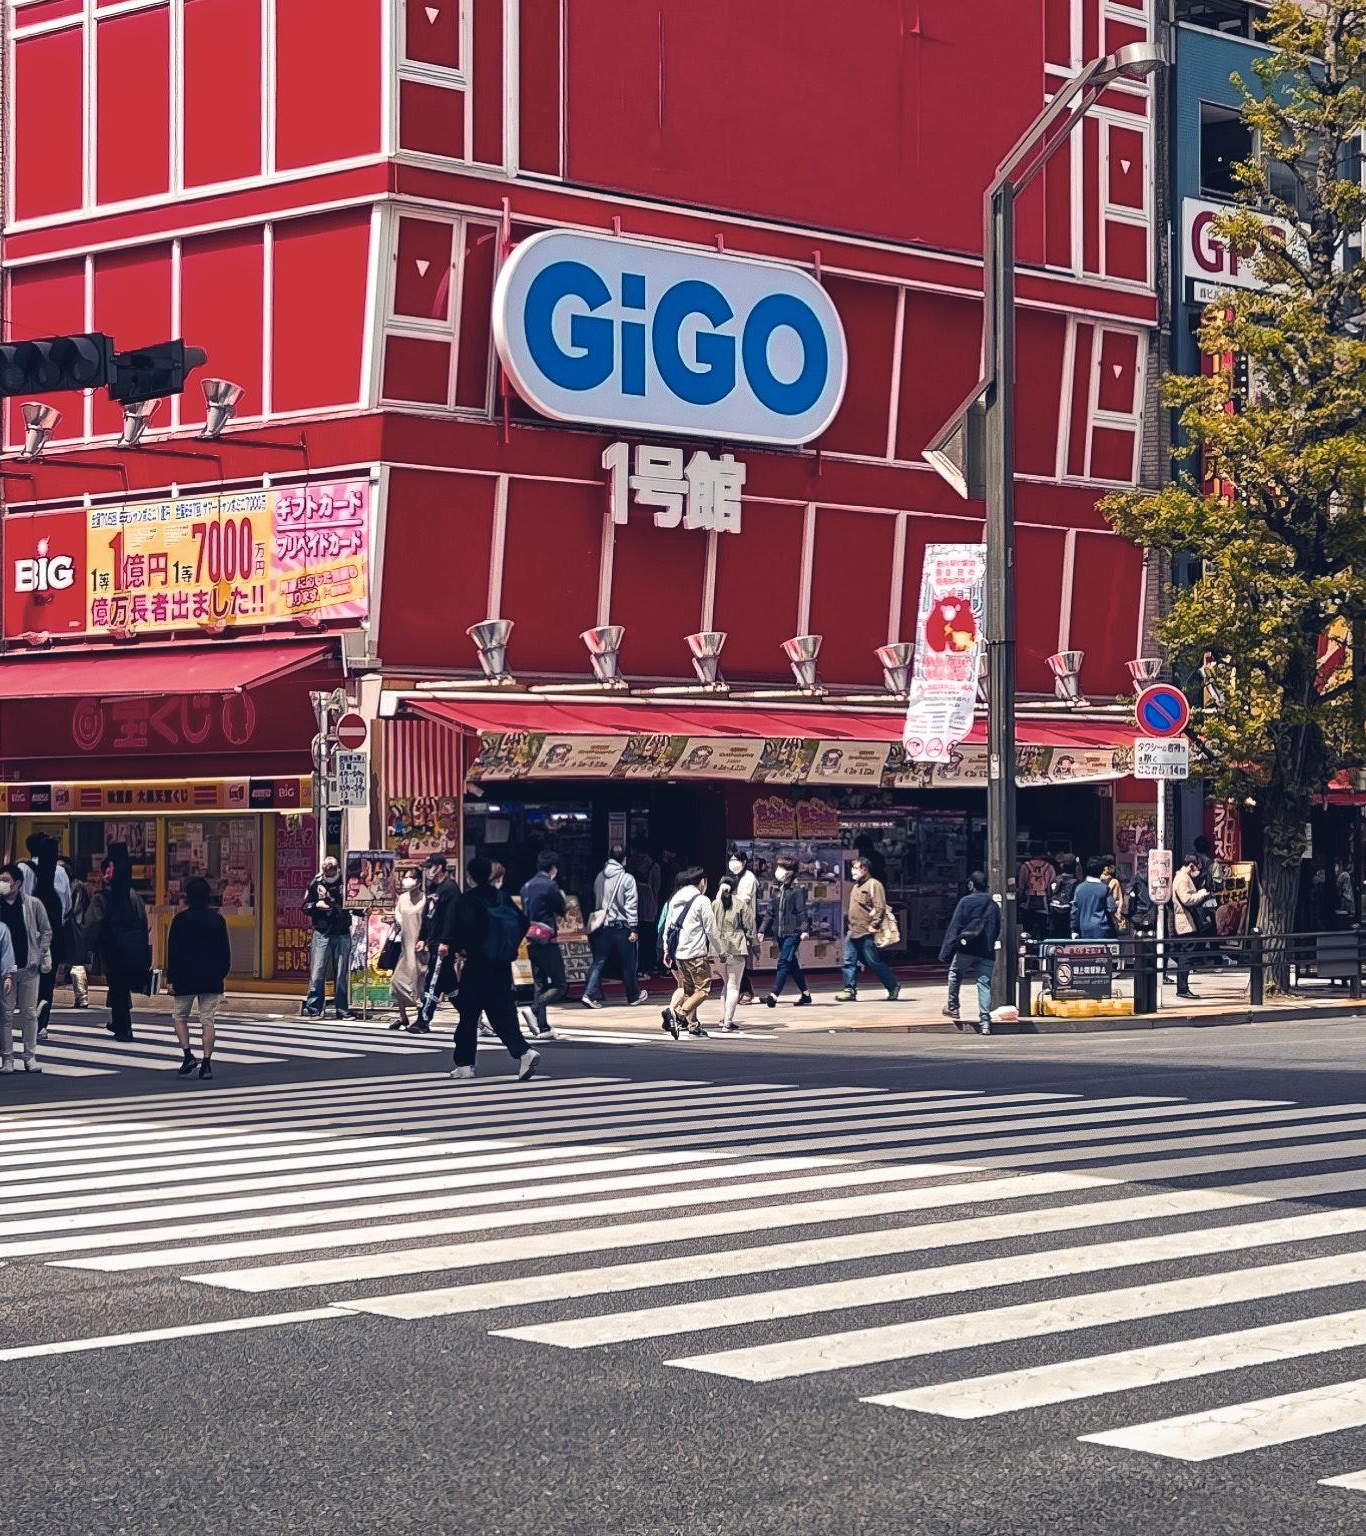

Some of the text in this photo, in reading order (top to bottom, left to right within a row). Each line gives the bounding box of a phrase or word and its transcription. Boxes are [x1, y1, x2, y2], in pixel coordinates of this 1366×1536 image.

[523, 260, 829, 416] GiGO
[275, 490, 365, 522] ギフトカード
[601, 441, 747, 534] 1号館
[14, 554, 75, 594] BIG
[91, 584, 266, 627] 億万長者出ました!!
